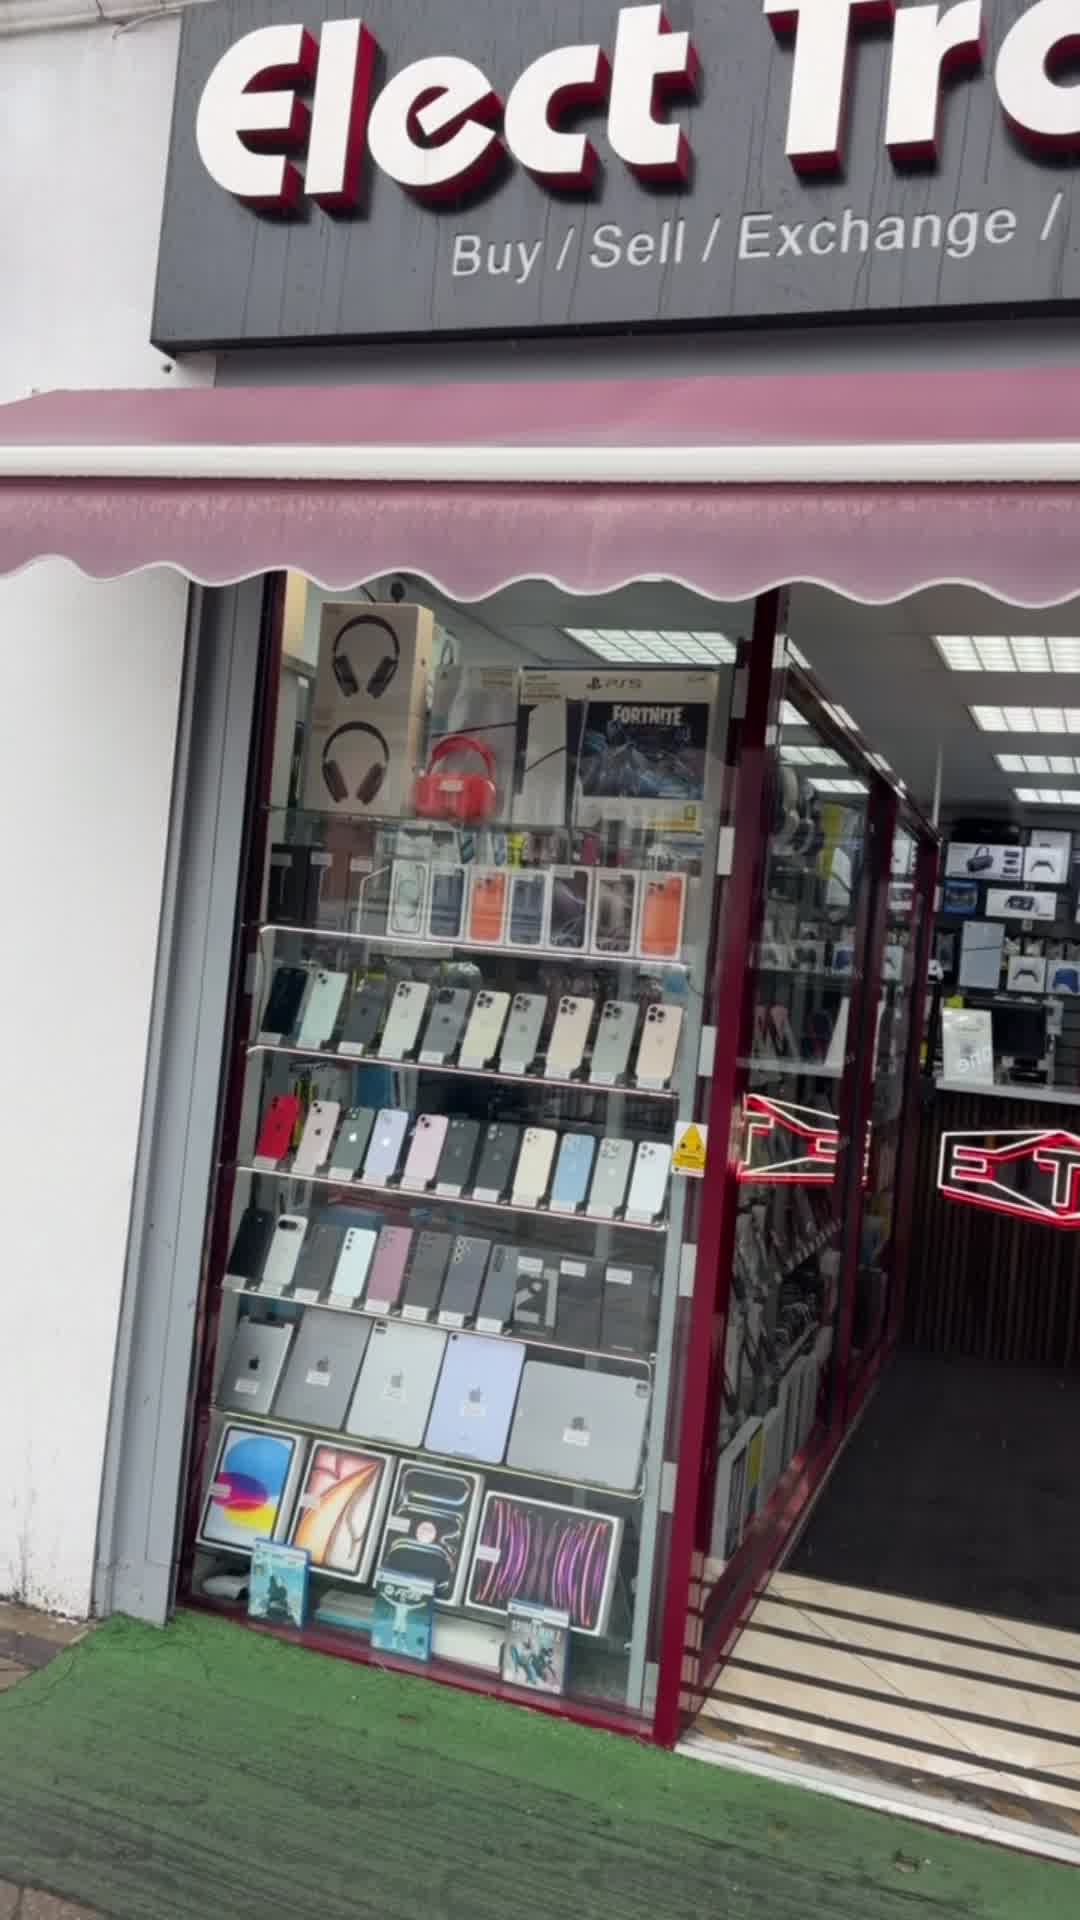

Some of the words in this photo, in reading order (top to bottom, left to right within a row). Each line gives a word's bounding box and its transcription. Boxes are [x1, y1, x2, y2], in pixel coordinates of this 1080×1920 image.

[196, 4, 694, 203] Elect
[451, 235, 543, 284] Buy
[555, 228, 575, 271] /
[589, 220, 686, 269] Sell
[701, 217, 721, 263] /
[738, 208, 1017, 260] Exchange
[1040, 192, 1063, 241] /
[612, 704, 684, 727] FORTNITE
